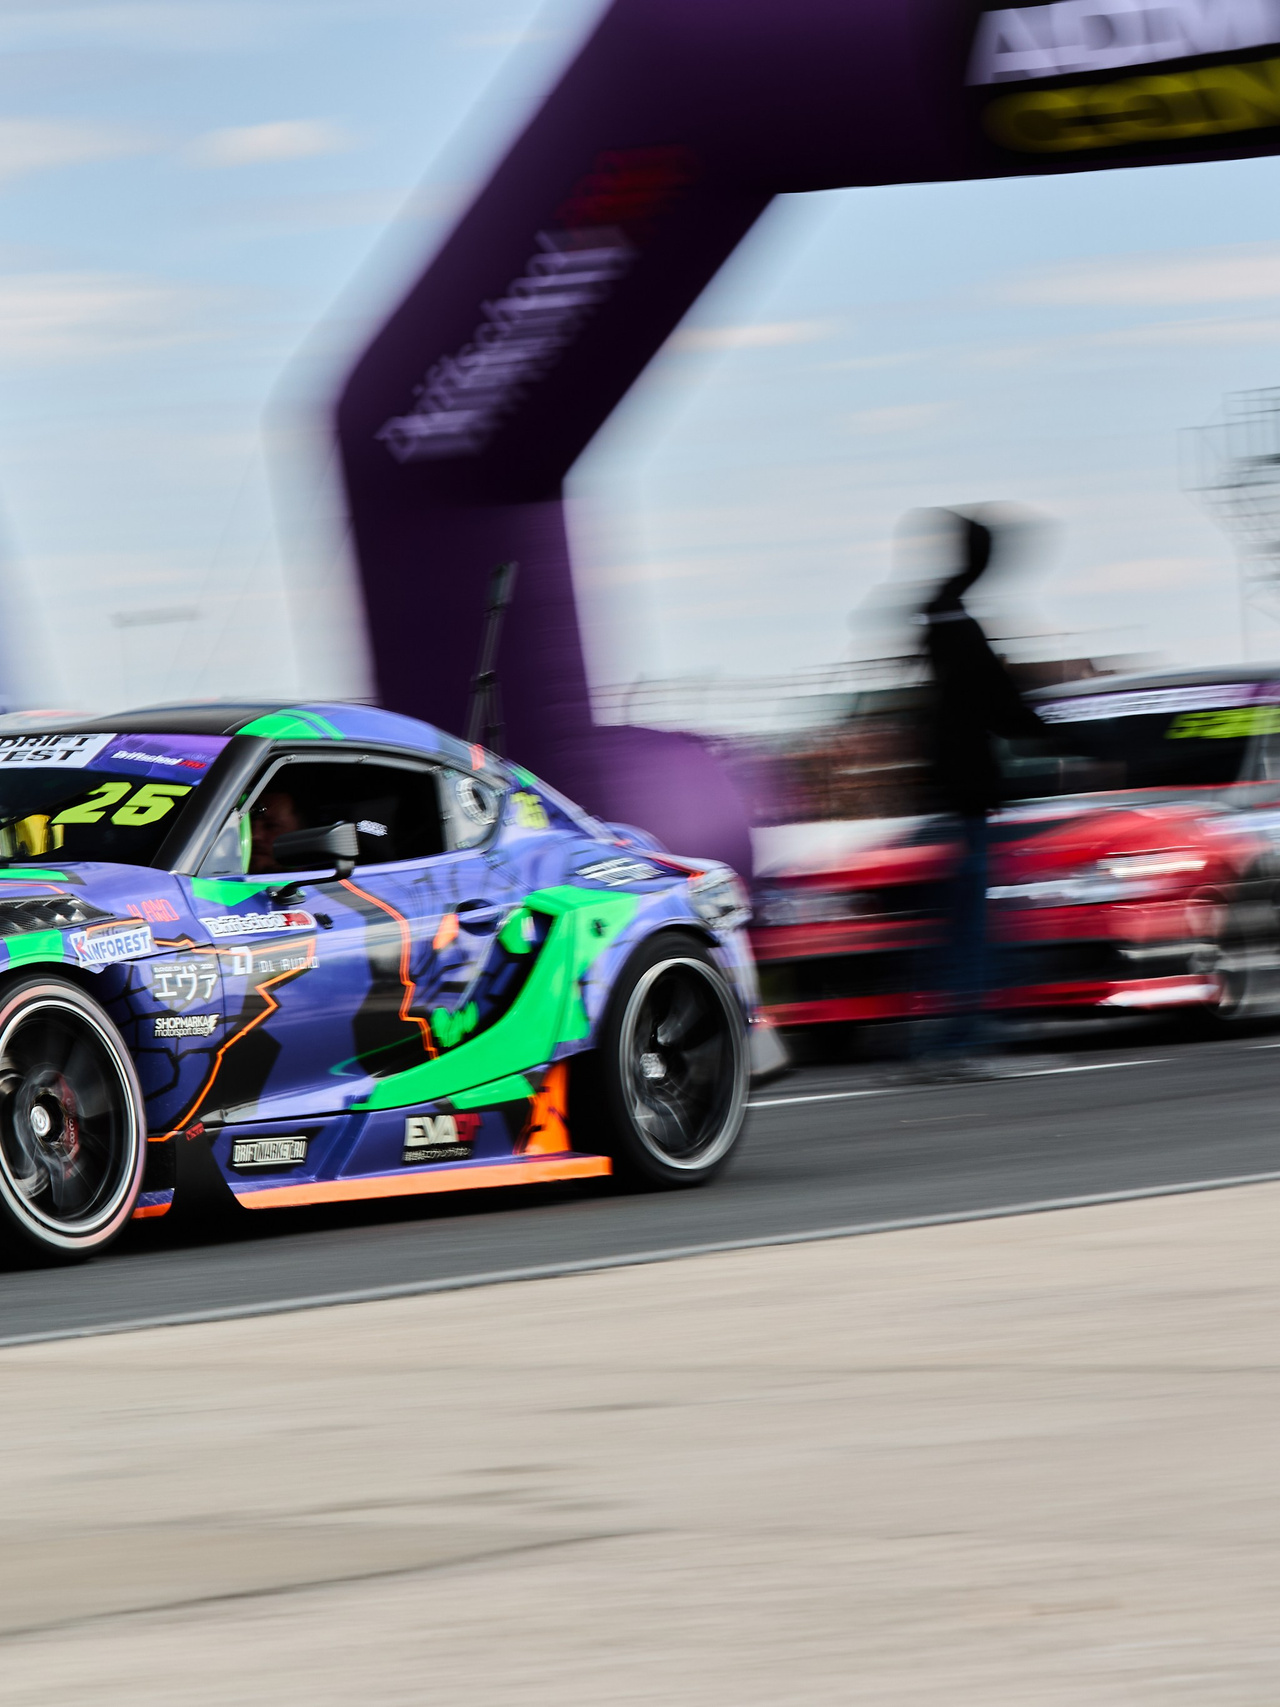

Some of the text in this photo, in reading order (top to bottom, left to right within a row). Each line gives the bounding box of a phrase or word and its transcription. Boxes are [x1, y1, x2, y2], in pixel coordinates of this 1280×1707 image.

[50, 781, 193, 827] 25
[73, 931, 148, 962] KINFOREST
[154, 964, 218, 1000] エヴァ
[154, 1015, 210, 1030] SHOPMARKA
[154, 1027, 192, 1038] motorsport
